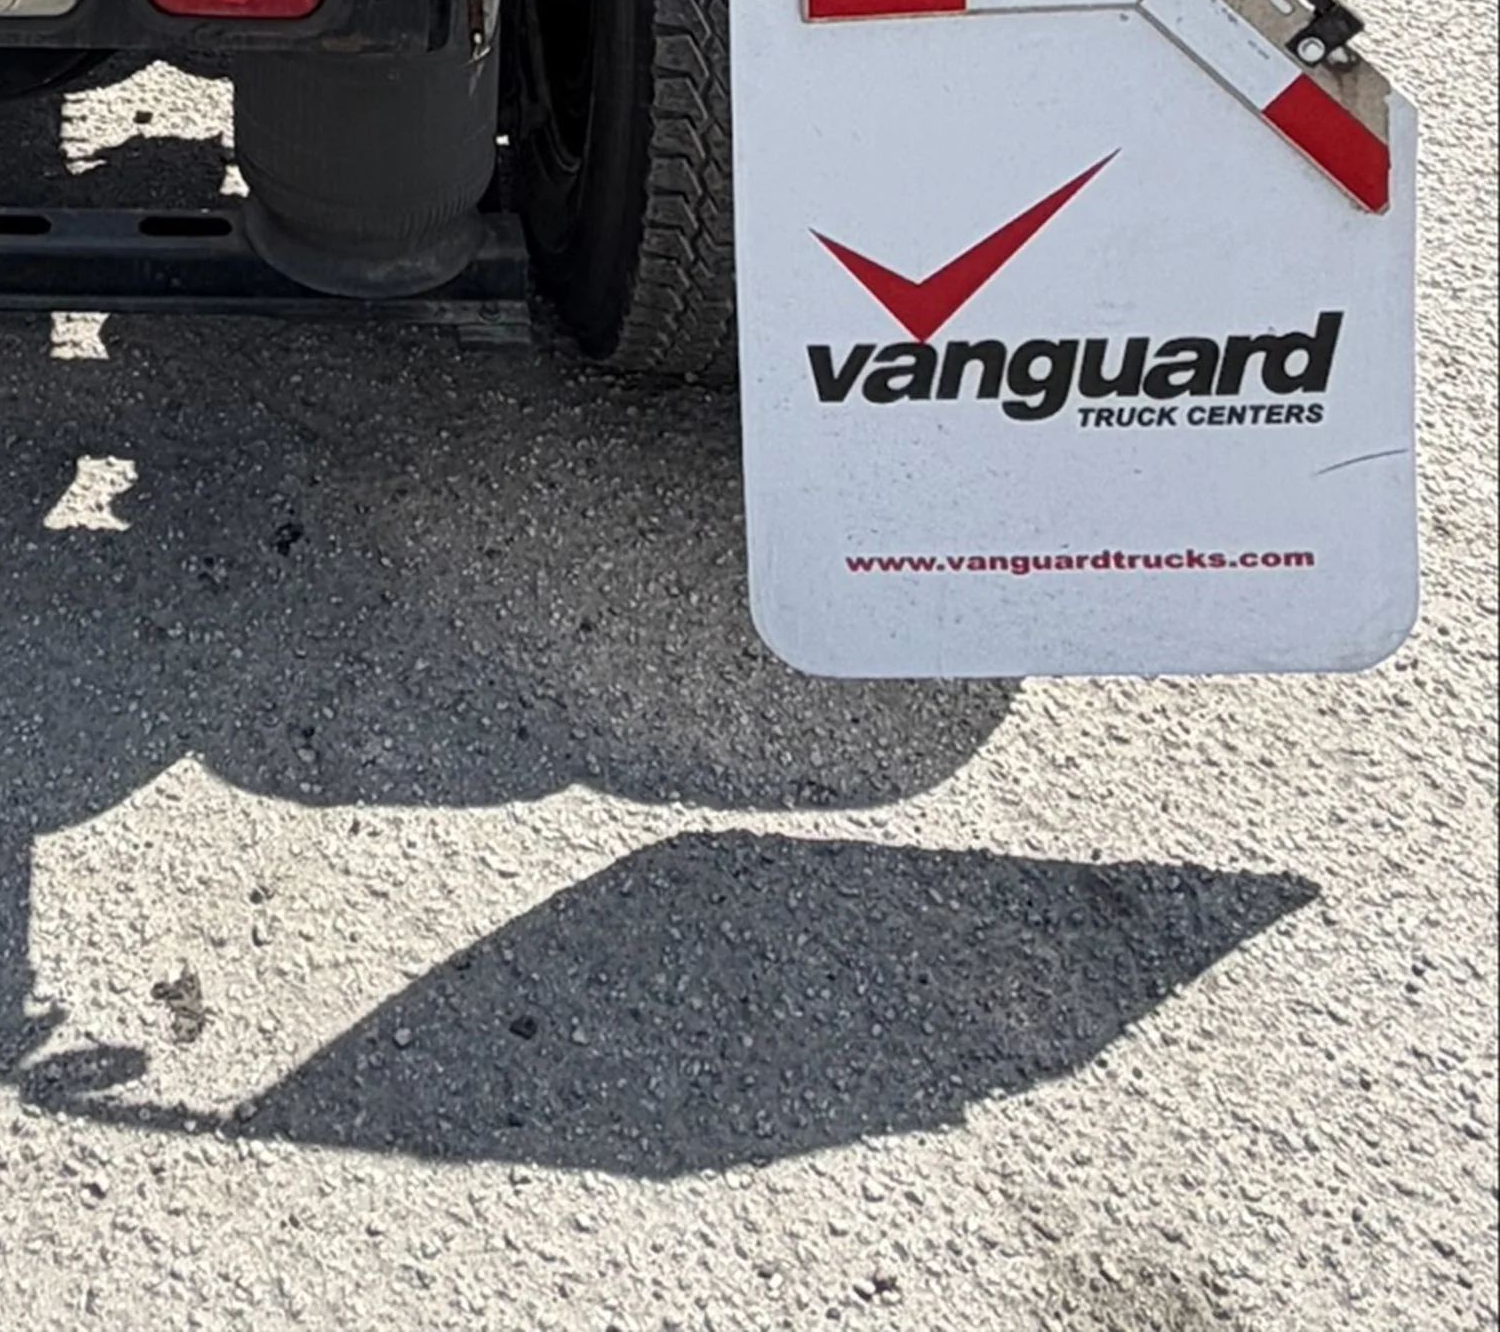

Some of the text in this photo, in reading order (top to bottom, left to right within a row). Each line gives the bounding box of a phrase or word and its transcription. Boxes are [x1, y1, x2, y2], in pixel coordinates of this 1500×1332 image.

[807, 311, 1343, 421] vanguard
[1078, 404, 1324, 428] TRUCK CENTERS
[845, 549, 1315, 576] www.vanguardtrucks.com
